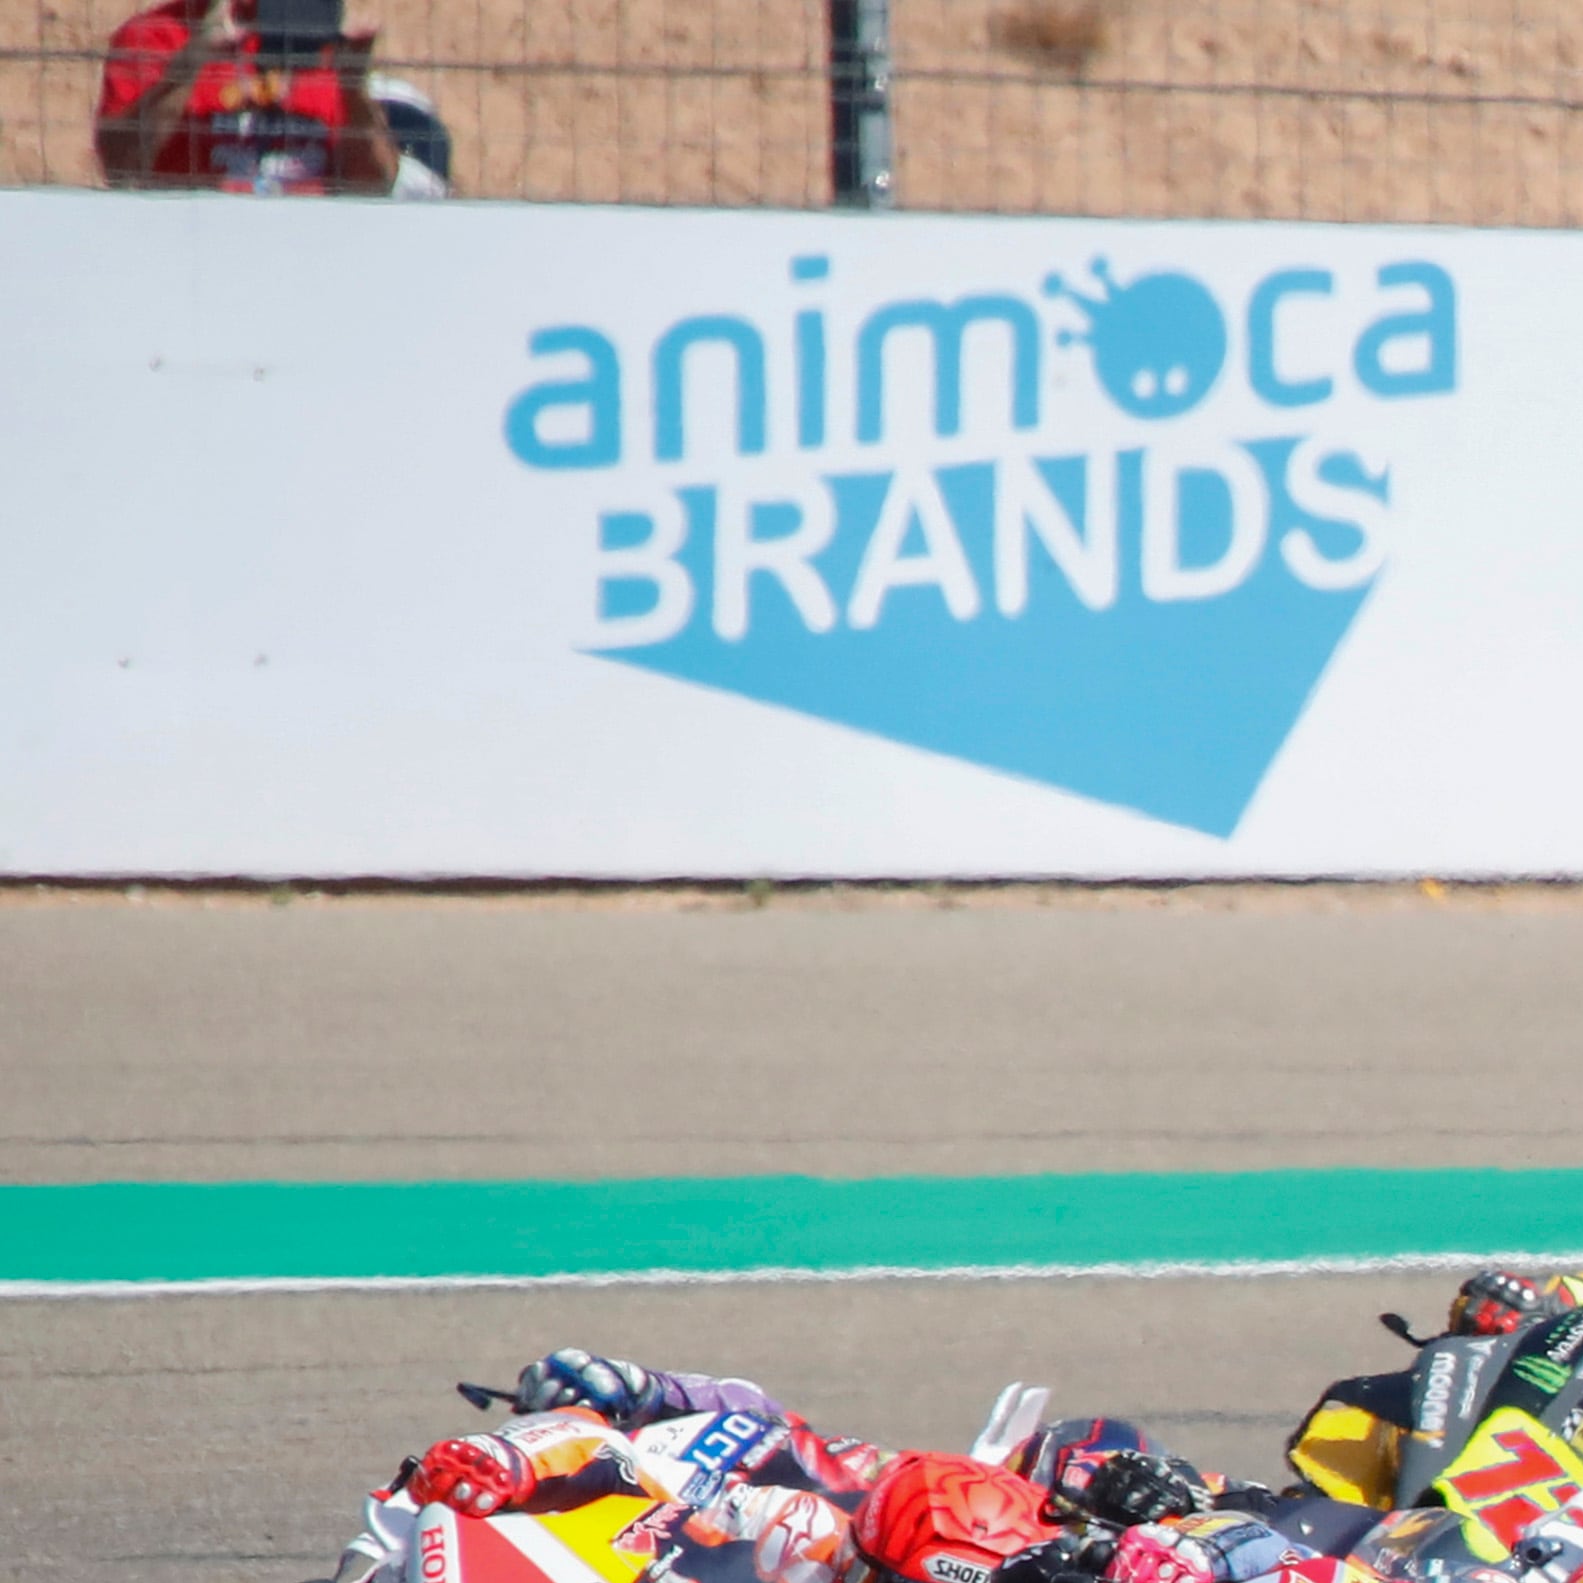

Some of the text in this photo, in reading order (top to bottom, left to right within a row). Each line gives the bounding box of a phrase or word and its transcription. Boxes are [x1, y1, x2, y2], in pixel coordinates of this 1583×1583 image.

[503, 254, 1457, 471] animoca
[574, 432, 1390, 650] BRANDS
[691, 1413, 758, 1470] OCT
